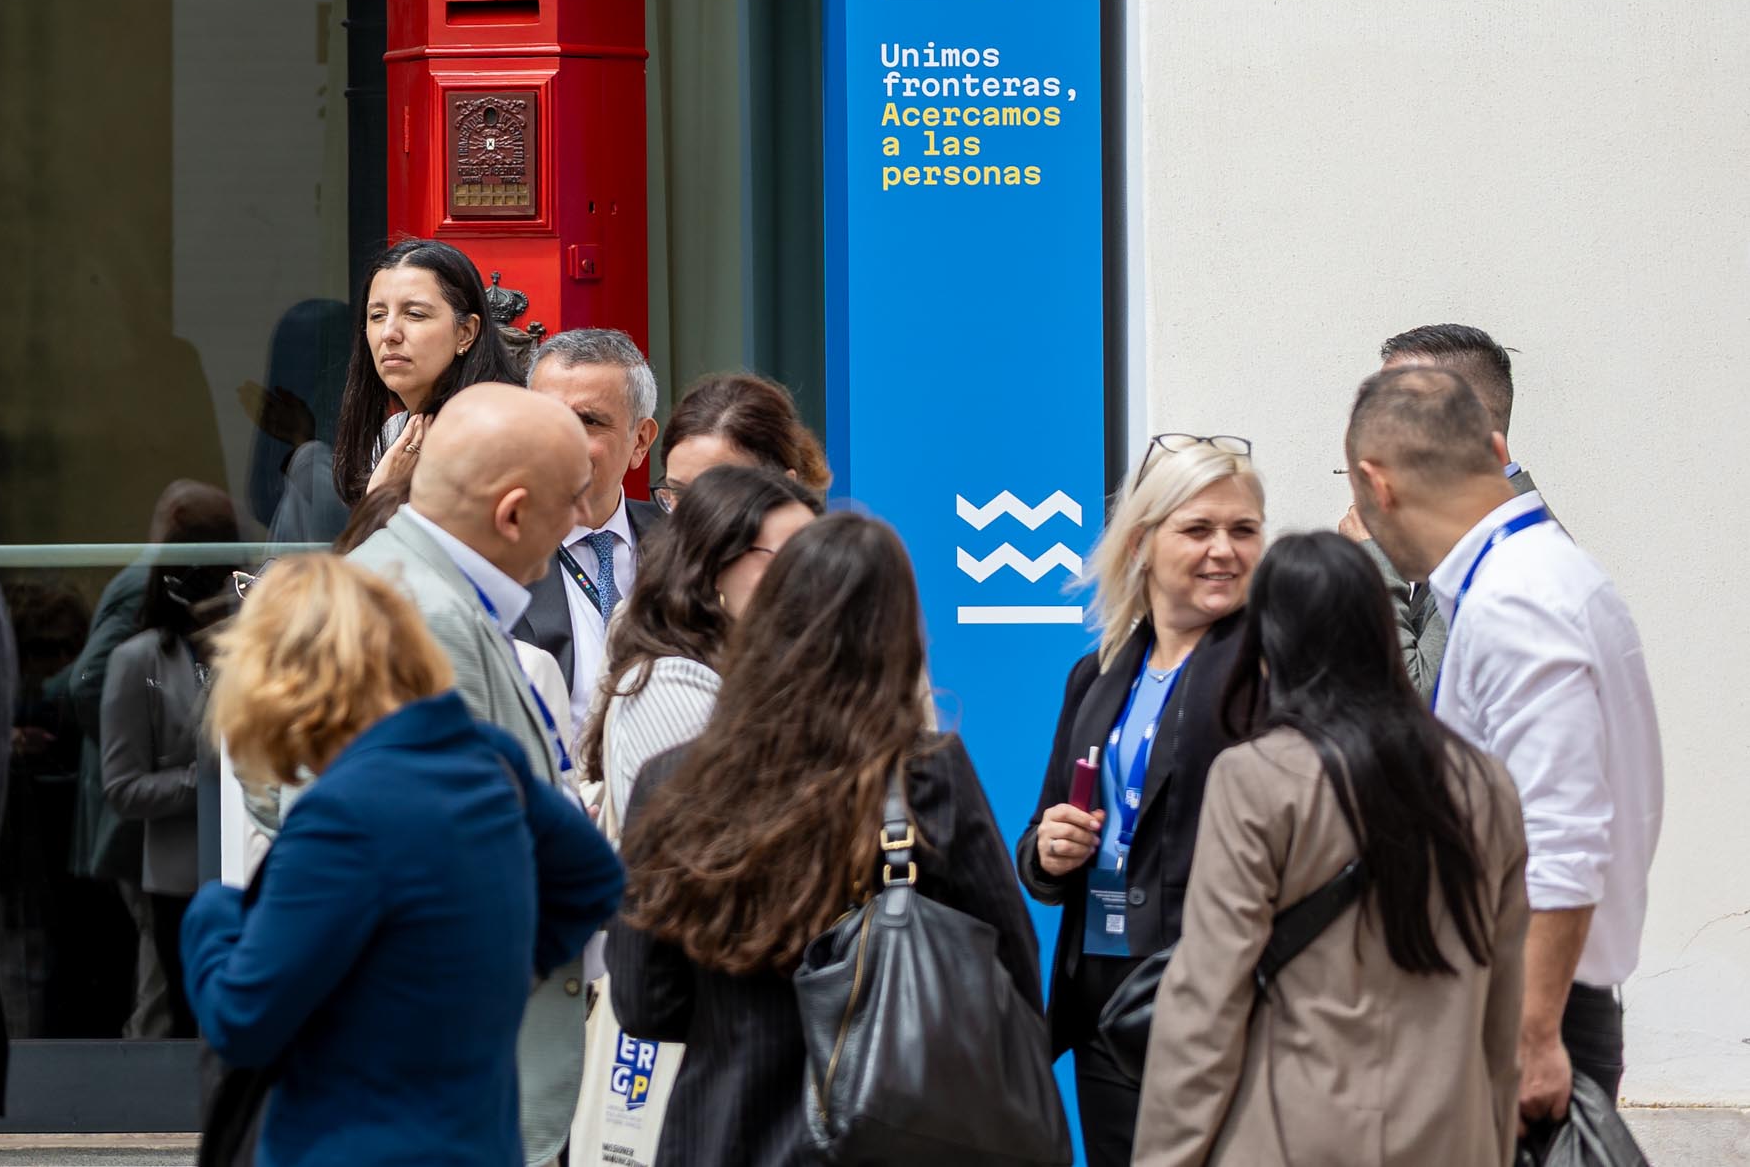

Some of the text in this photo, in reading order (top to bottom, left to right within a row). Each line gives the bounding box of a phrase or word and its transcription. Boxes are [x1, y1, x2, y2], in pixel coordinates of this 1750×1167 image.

[881, 42, 999, 67] Unimos
[883, 71, 1076, 101] fronteras,
[882, 103, 1060, 126] Acercamos
[882, 131, 980, 156] a las
[883, 166, 1041, 191] personas
